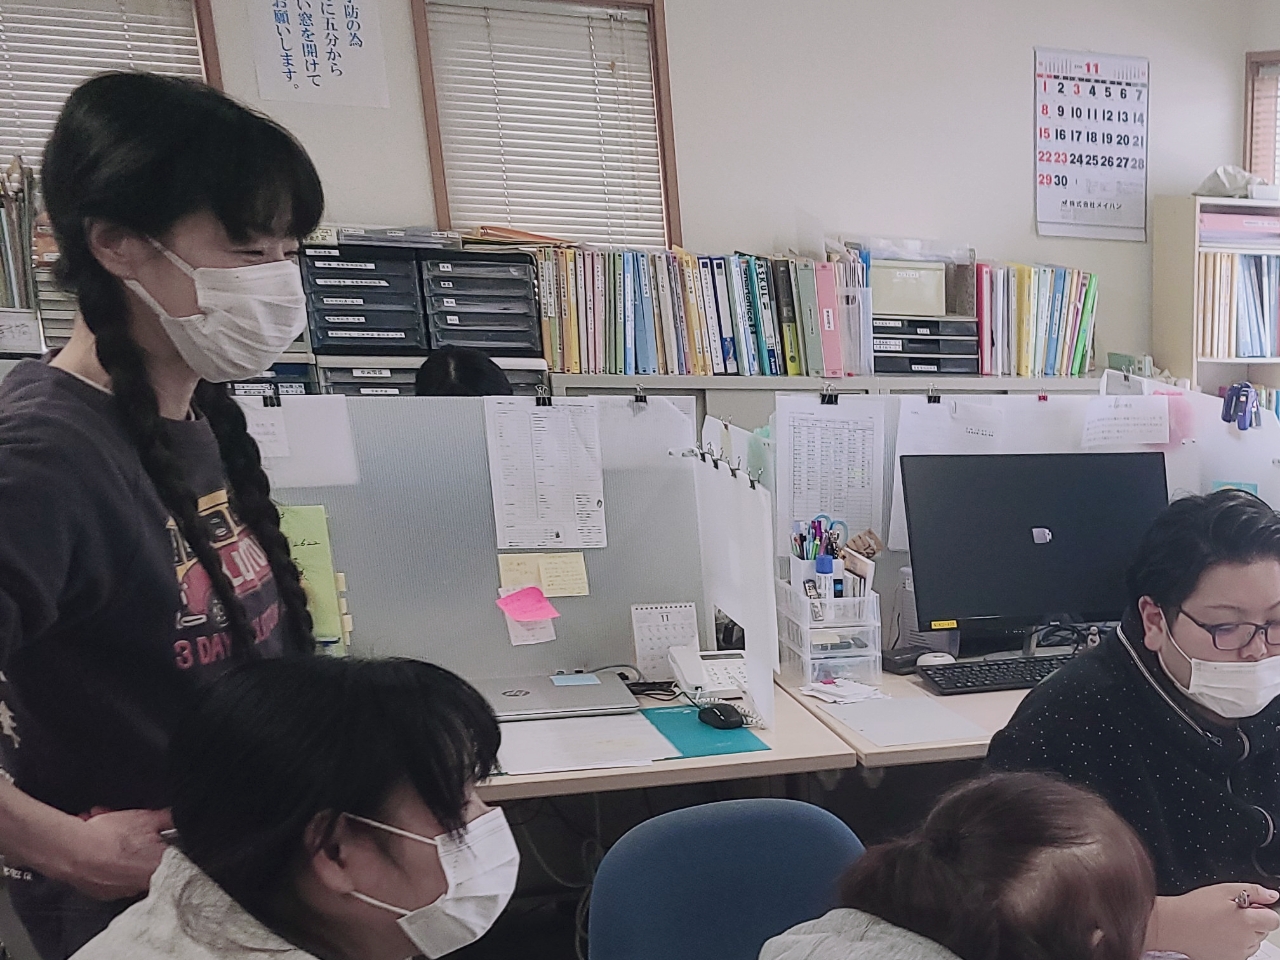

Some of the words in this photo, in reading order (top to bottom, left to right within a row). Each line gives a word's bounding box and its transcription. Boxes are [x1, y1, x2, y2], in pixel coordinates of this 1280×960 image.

[343, 0, 363, 48] 防の為
[1085, 62, 1100, 74] 11
[1043, 81, 1047, 93] 1
[1058, 82, 1064, 93] 2
[1074, 83, 1080, 95] 3
[1089, 85, 1096, 97] 4
[1105, 87, 1111, 98] 5
[1120, 88, 1127, 99] 6
[1136, 90, 1143, 101] 7
[1042, 104, 1048, 116] 8
[1058, 106, 1064, 116] 9
[1071, 106, 1082, 119] 10
[1087, 108, 1097, 120] 11
[1102, 109, 1113, 121] 12
[1118, 111, 1128, 123] 13
[1133, 112, 1144, 124] 14
[1039, 127, 1050, 139] 15
[1055, 128, 1066, 140] 16
[1071, 130, 1082, 142] 17
[1086, 131, 1097, 143] 18
[1102, 132, 1112, 144] 19
[1116, 134, 1129, 145] 20
[1133, 135, 1143, 147] 21
[1038, 151, 1051, 162] 22
[1054, 152, 1067, 164] 23
[1070, 153, 1083, 165] 24
[1085, 155, 1098, 166] 25
[1100, 156, 1114, 167] 26
[1116, 157, 1129, 168] 27
[1130, 158, 1144, 169] 28
[1038, 174, 1051, 185] 29
[1054, 175, 1067, 186] 30
[757, 262, 768, 297] ASKUL
[660, 614, 669, 622] 11
